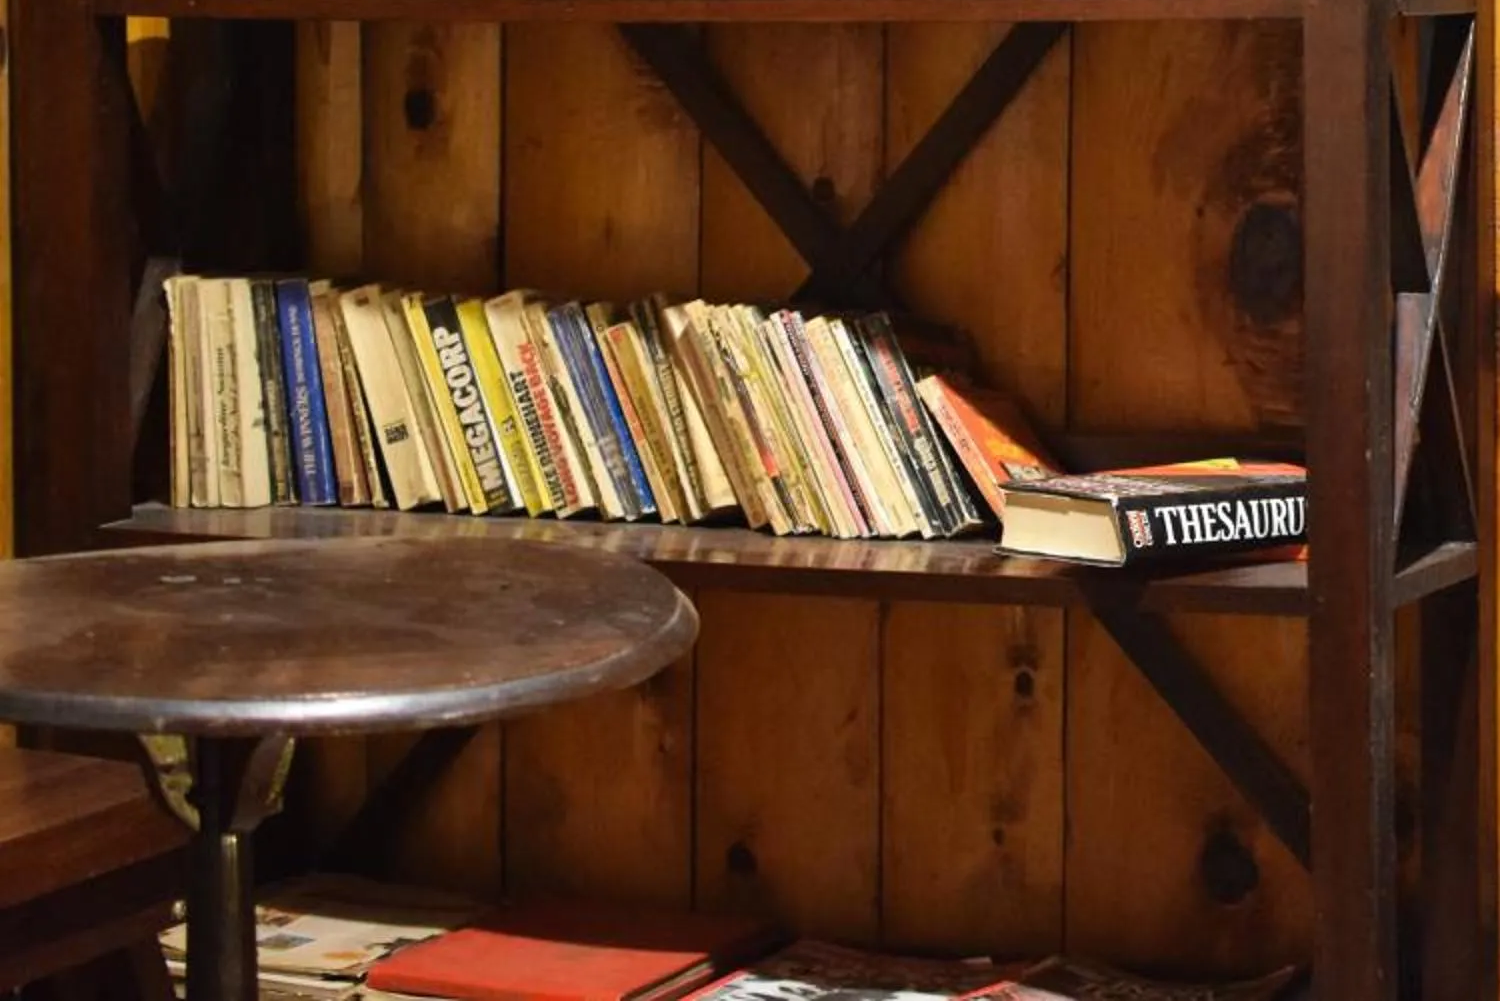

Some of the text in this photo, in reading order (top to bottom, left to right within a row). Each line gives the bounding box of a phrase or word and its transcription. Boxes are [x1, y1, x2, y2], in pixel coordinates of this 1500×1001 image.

[295, 385, 314, 448] WINNERS
[432, 325, 504, 492] MEGACORP
[510, 370, 568, 511] LUKE RHINEHART
[516, 341, 580, 506] LONG VOYAGE BACK
[303, 451, 316, 476] THE
[1155, 496, 1308, 545] THESAURU
